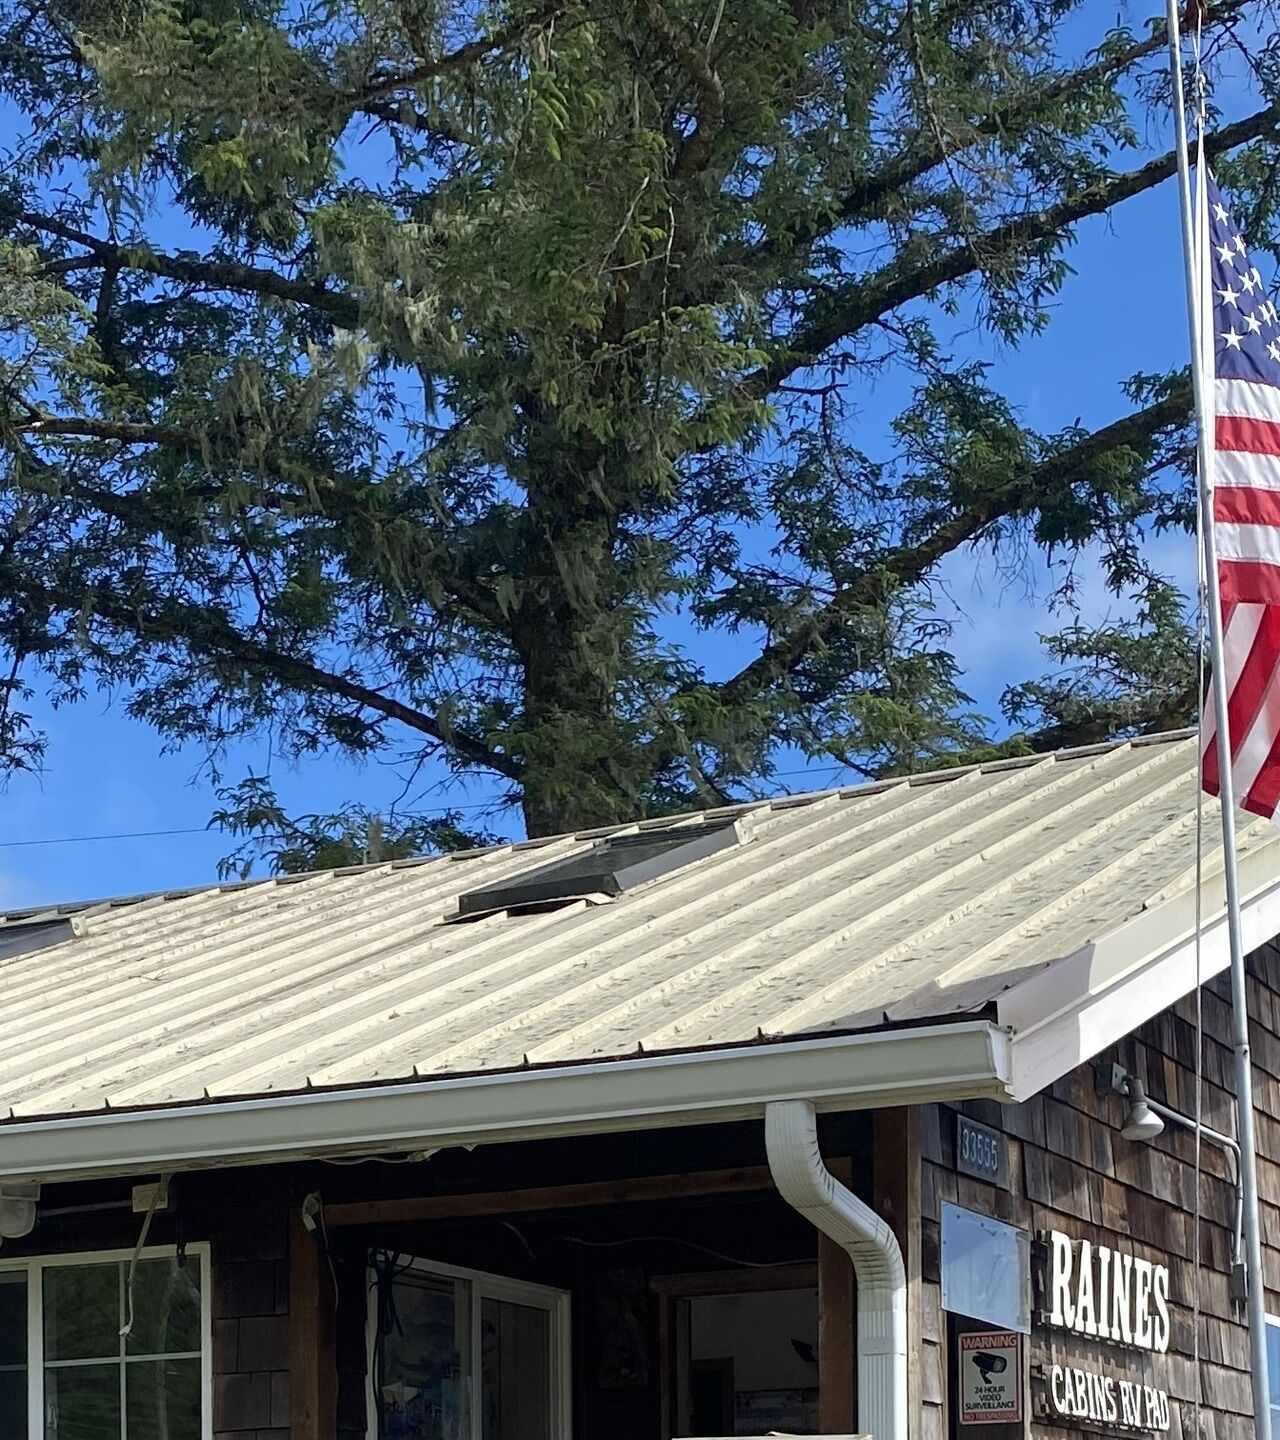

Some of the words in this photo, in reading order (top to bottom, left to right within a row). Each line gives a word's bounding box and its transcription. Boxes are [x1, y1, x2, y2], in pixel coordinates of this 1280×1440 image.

[963, 1128, 998, 1171] 33555
[1050, 1229, 1170, 1354] RAINES
[962, 1335, 1017, 1349] WARNING
[965, 1401, 1016, 1410] SURVEILLANCE
[1051, 1364, 1118, 1423] CABINS
[1119, 1380, 1142, 1428] RV
[1144, 1385, 1170, 1431] PAD
